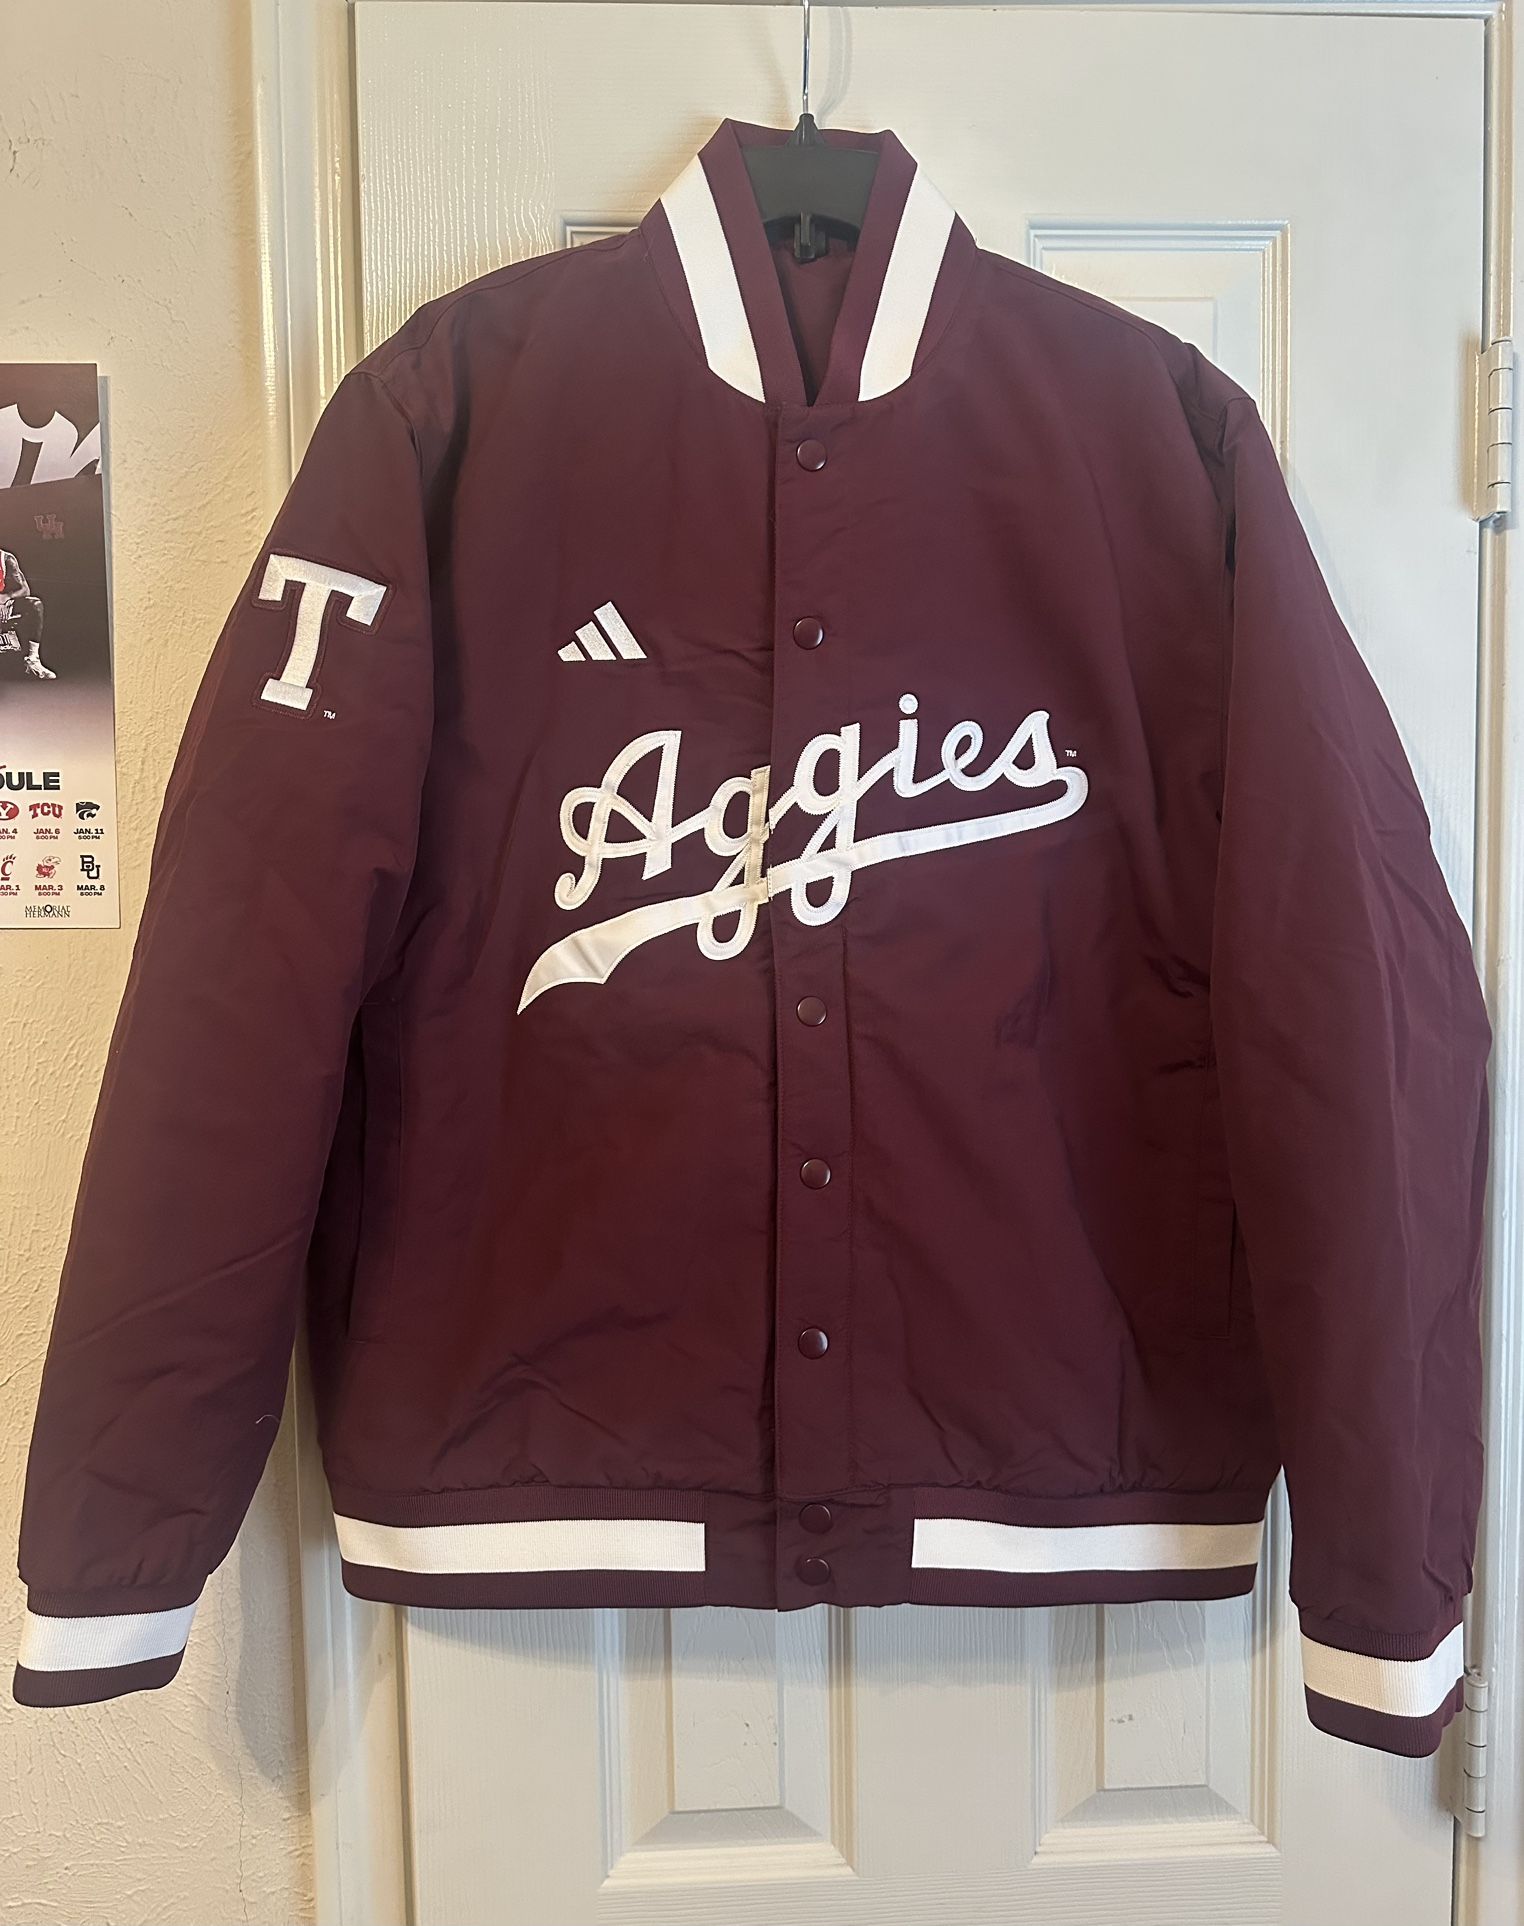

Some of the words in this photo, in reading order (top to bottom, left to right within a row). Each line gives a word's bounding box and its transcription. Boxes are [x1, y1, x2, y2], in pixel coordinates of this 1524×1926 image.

[258, 554, 387, 711] T
[29, 802, 63, 819] TCU
[554, 693, 1090, 961] Aggies
[80, 855, 101, 879] BU
[25, 905, 71, 913] MEMORIAL
